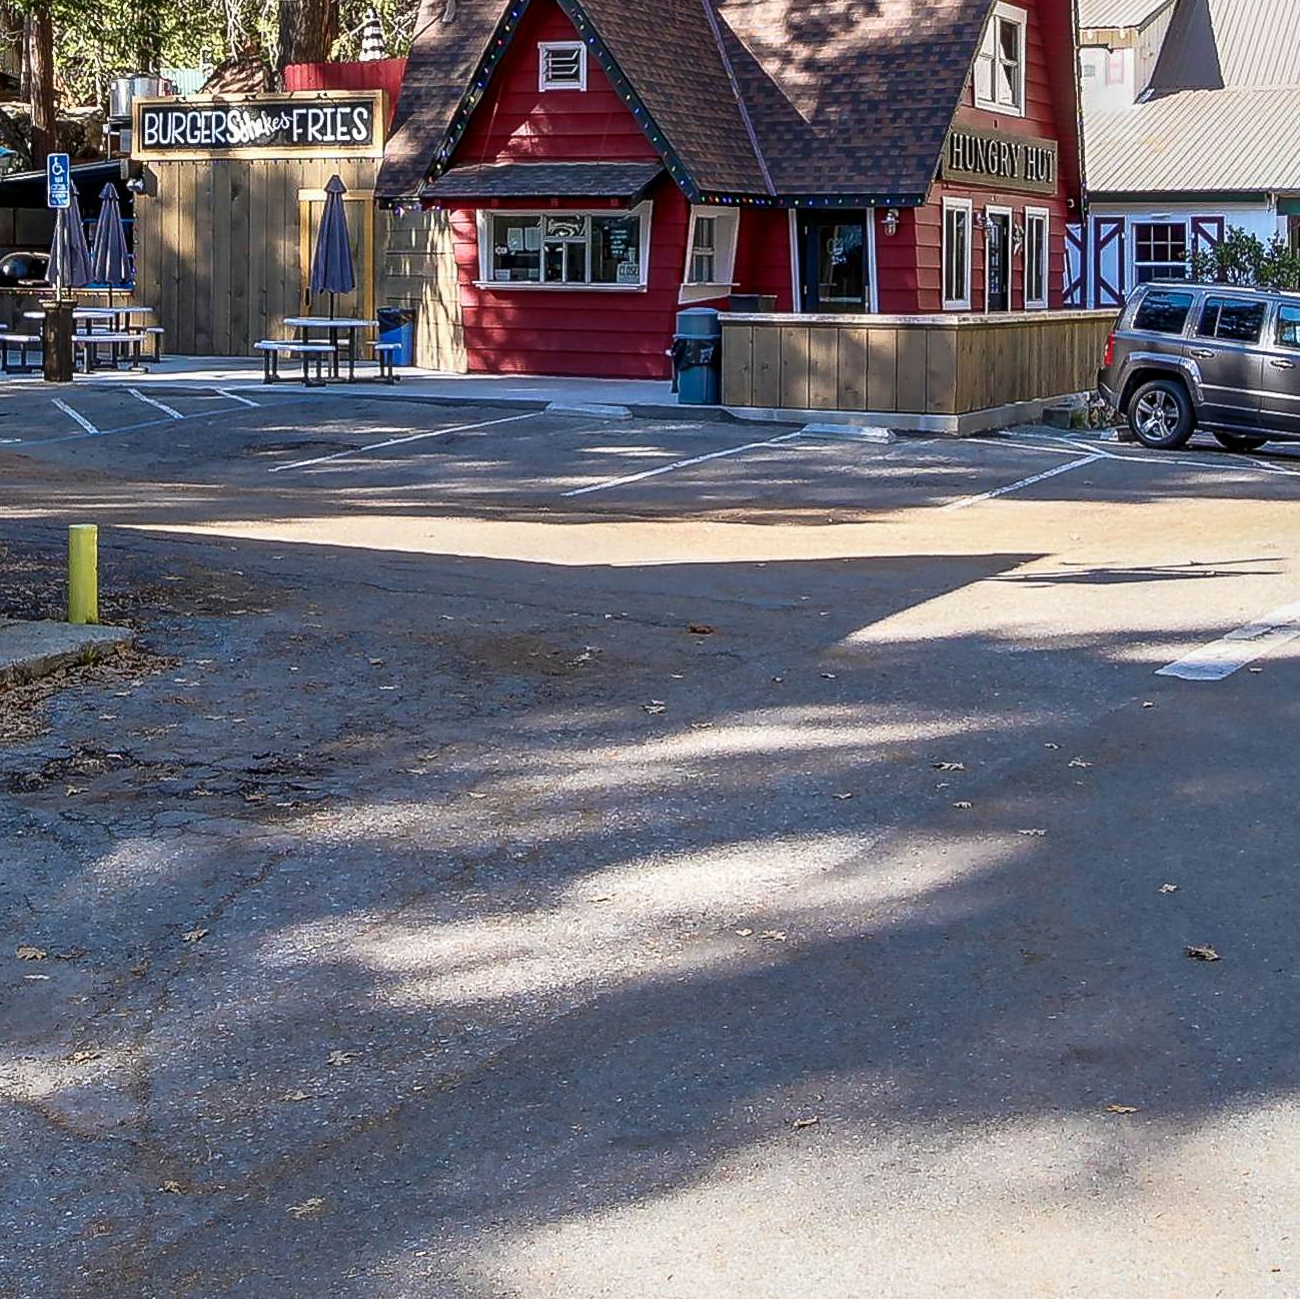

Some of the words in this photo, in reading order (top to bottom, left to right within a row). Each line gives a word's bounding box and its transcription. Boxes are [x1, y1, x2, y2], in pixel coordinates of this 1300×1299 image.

[144, 110, 242, 145] BURGERS
[292, 107, 368, 142] FRIES
[949, 132, 1021, 178] HUNGRY
[1025, 146, 1055, 183] HUT
